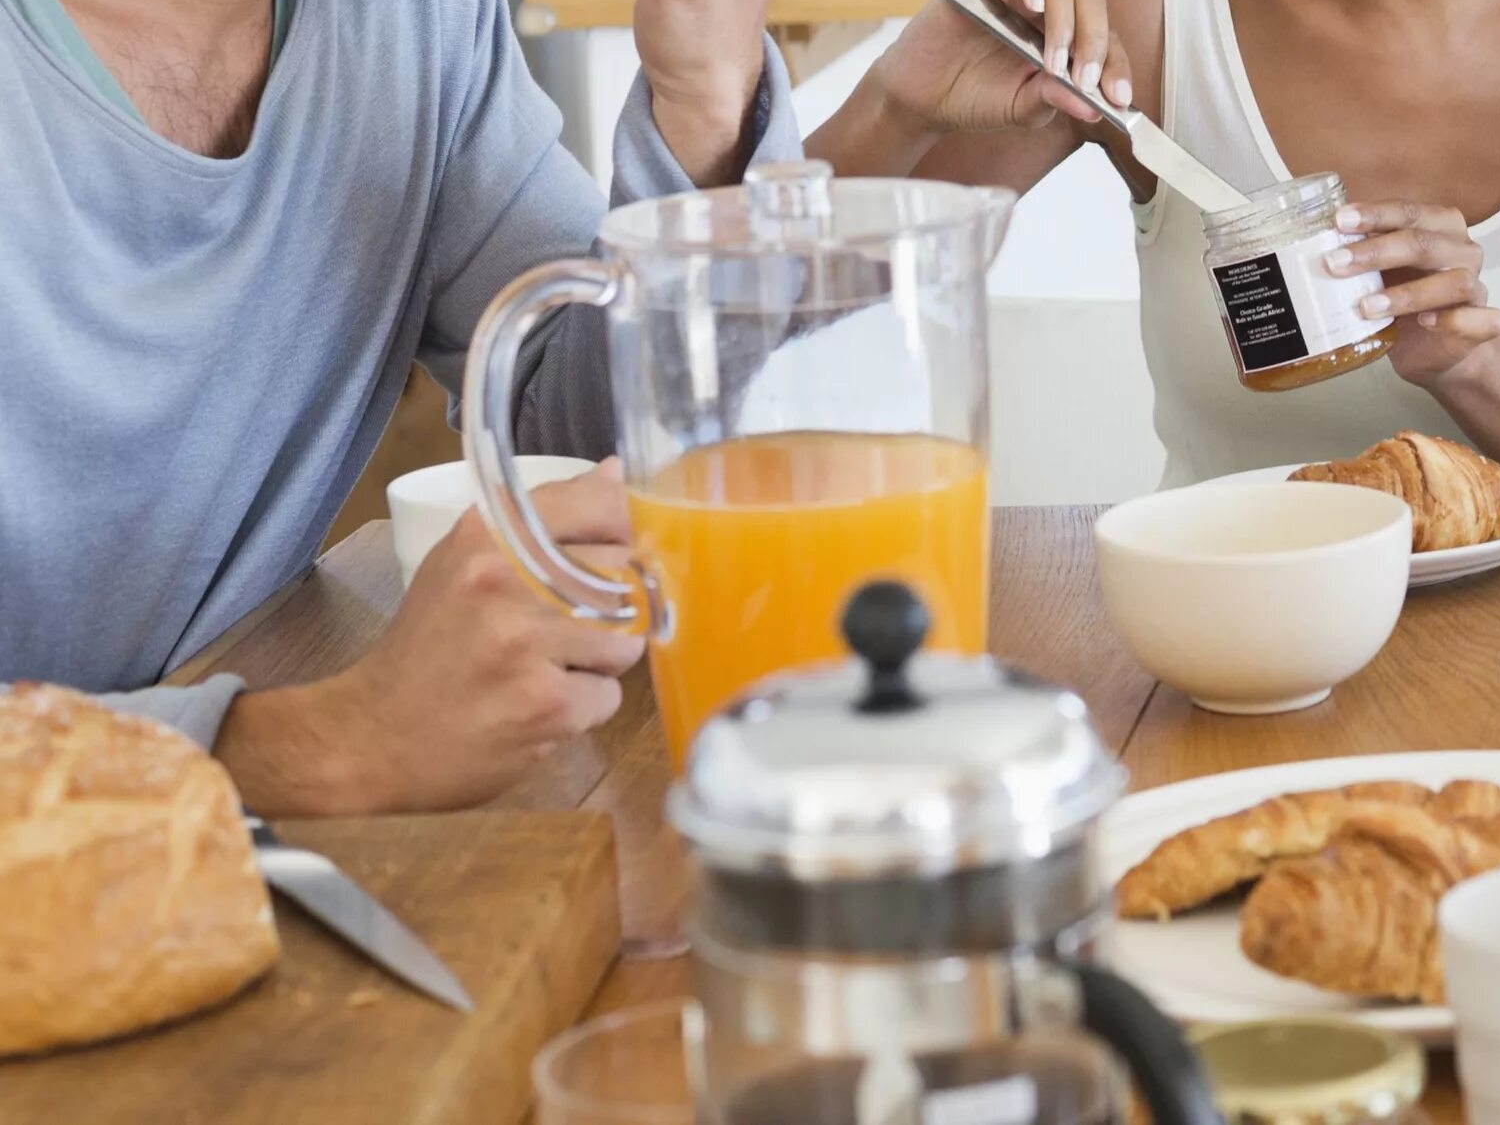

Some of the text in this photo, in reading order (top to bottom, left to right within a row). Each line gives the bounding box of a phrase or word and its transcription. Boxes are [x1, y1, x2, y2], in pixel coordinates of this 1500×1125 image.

[1256, 303, 1273, 312] Grade
[1252, 311, 1268, 321] South
[1268, 307, 1285, 316] Africa
